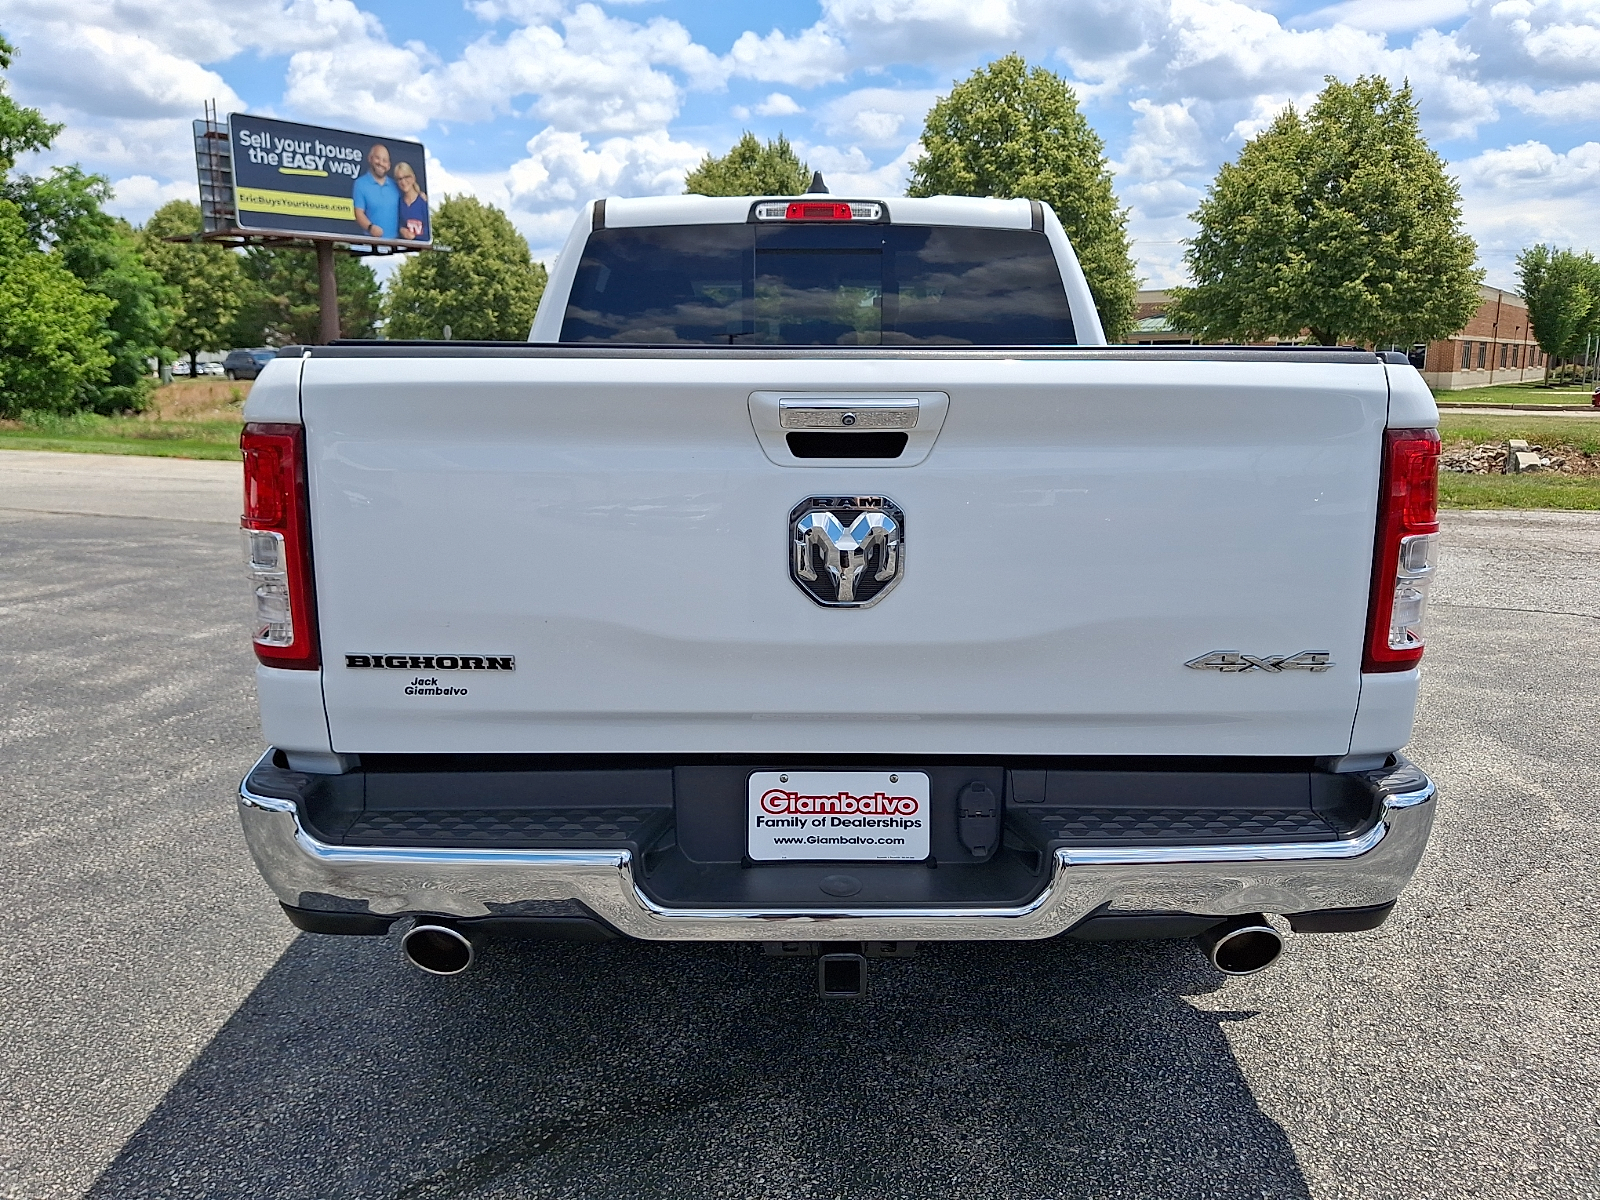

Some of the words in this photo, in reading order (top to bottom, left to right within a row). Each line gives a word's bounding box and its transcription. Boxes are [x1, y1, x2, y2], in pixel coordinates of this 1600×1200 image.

[239, 129, 271, 149] Sell
[273, 136, 312, 154] your
[314, 139, 362, 162] house
[248, 147, 279, 166] the
[282, 151, 326, 171] EASY
[328, 160, 361, 179] way
[239, 194, 352, 212] EricBuysYourHouse.com
[812, 498, 883, 508] RAM
[345, 652, 516, 671] BIGHORN
[1184, 650, 1336, 673] 4x4
[404, 686, 469, 696] Giambalvo
[411, 677, 439, 687] Jack
[760, 788, 920, 816] Giambalvo
[756, 815, 808, 830] Family
[811, 815, 827, 829] of
[830, 815, 923, 830] Dealerships
[773, 835, 906, 846] www.Giambalvo.com
